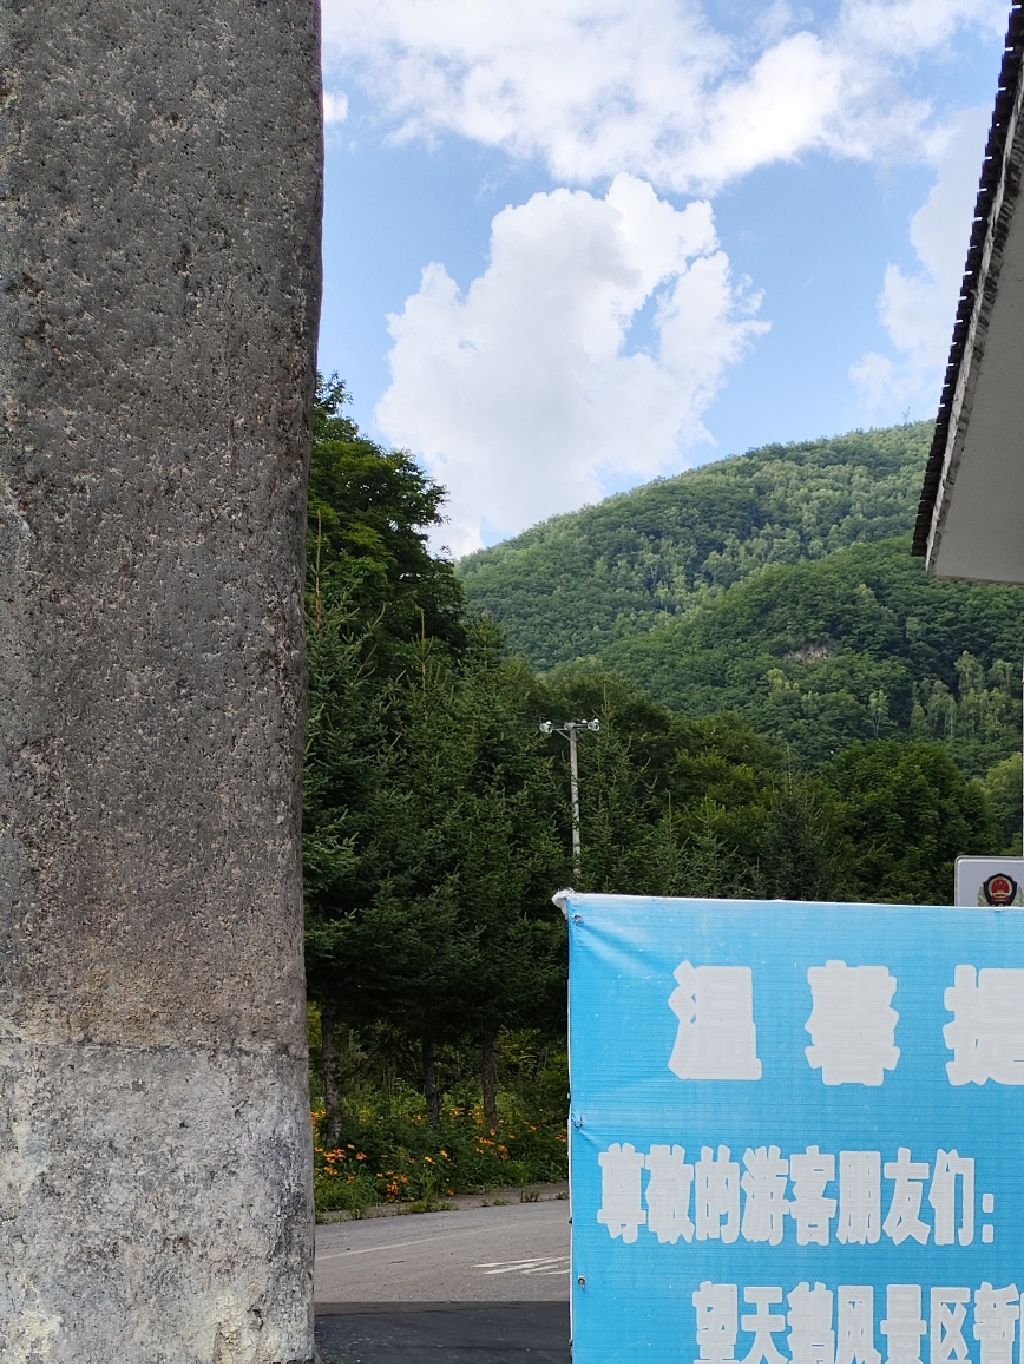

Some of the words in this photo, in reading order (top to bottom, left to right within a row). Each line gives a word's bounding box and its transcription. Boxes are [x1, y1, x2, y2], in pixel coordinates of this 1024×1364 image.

[598, 1144, 993, 1245] 尊敬的游客朋友们：
